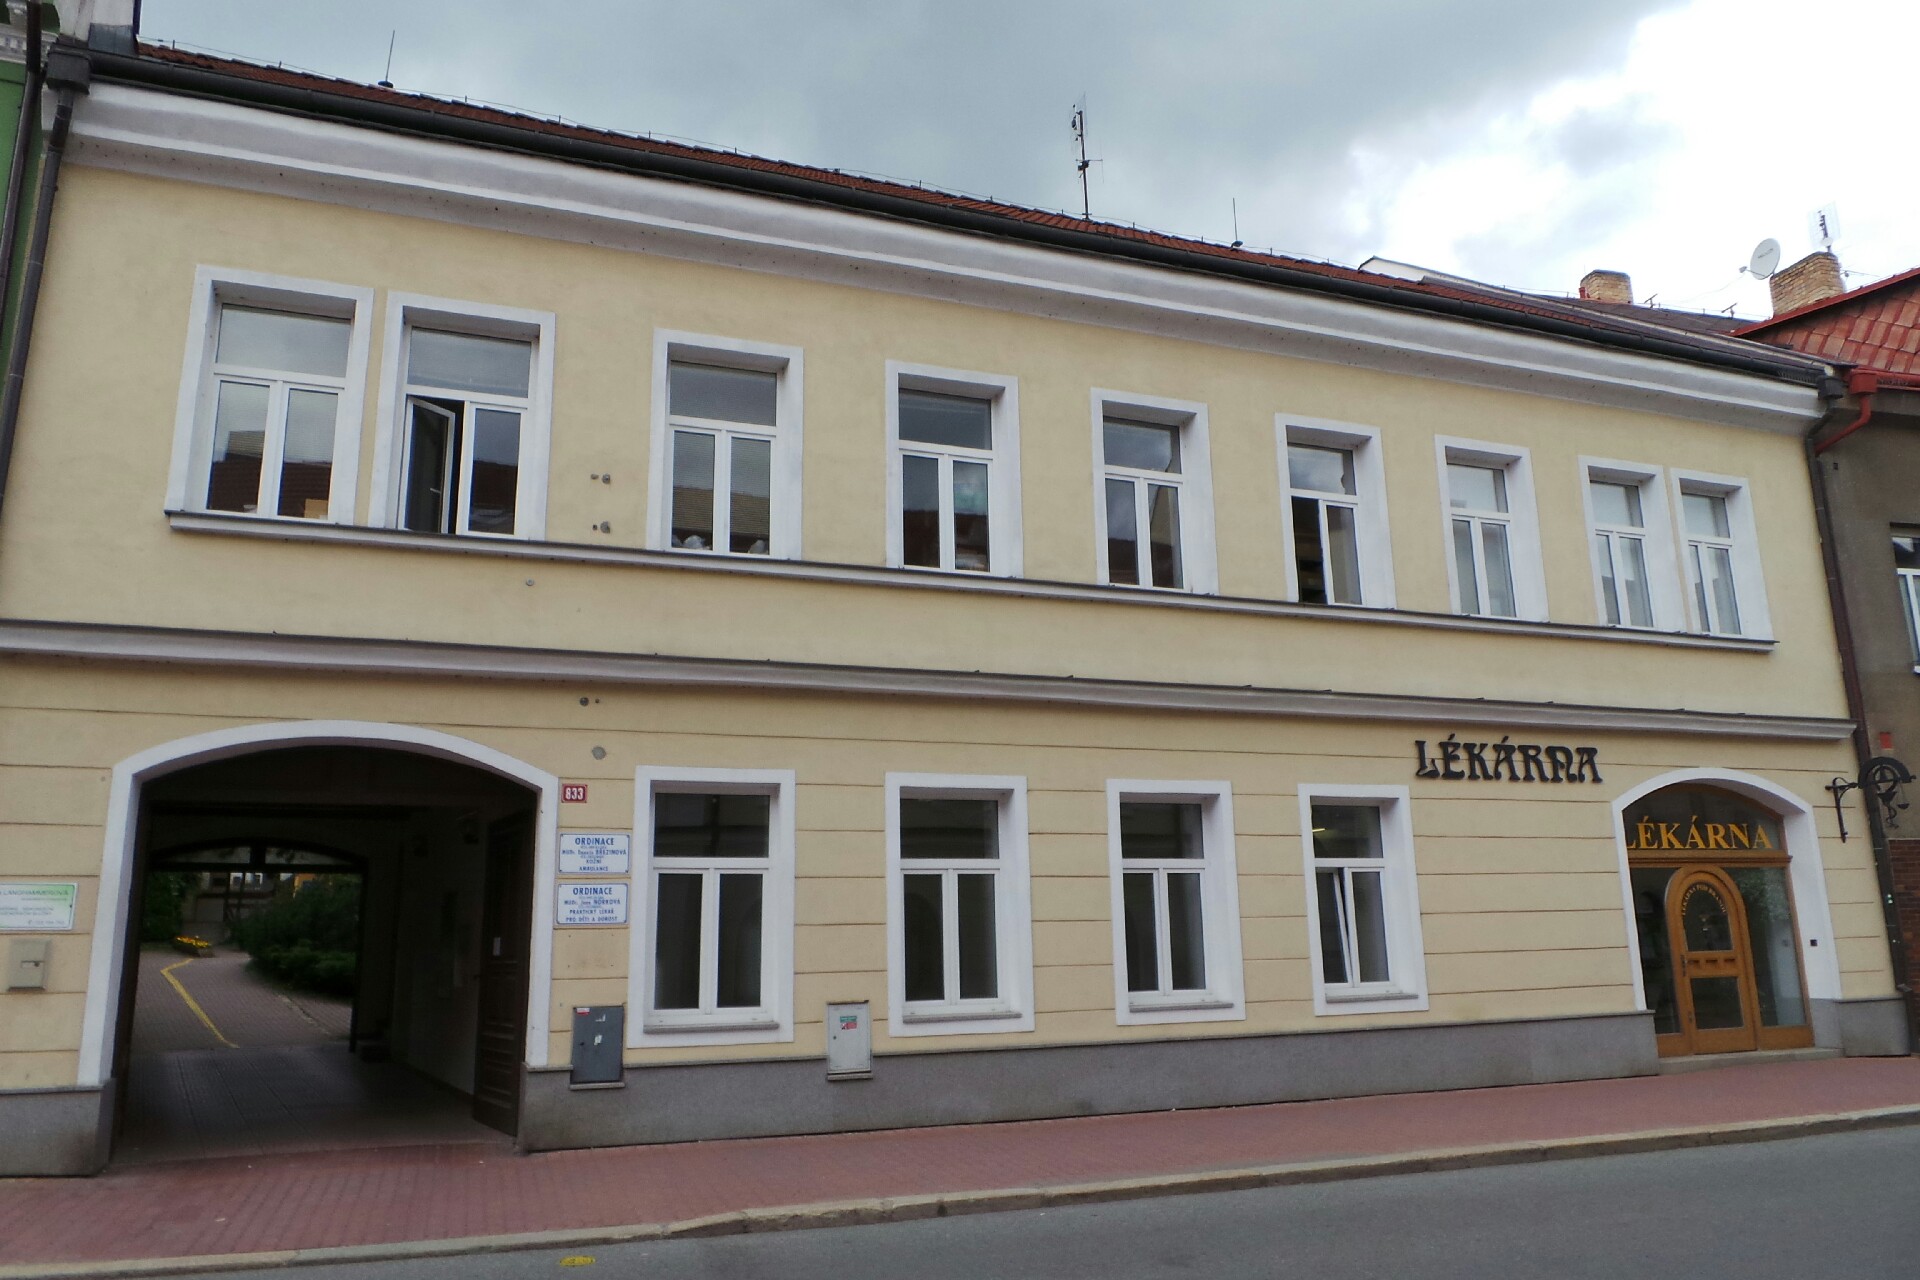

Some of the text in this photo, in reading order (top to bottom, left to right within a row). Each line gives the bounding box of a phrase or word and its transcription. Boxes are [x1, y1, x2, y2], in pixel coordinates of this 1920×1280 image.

[1415, 733, 1603, 783] LÉKÁRNA
[565, 787, 584, 800] 833
[574, 837, 614, 846] ORDINACE
[572, 887, 613, 895] ORDINACE
